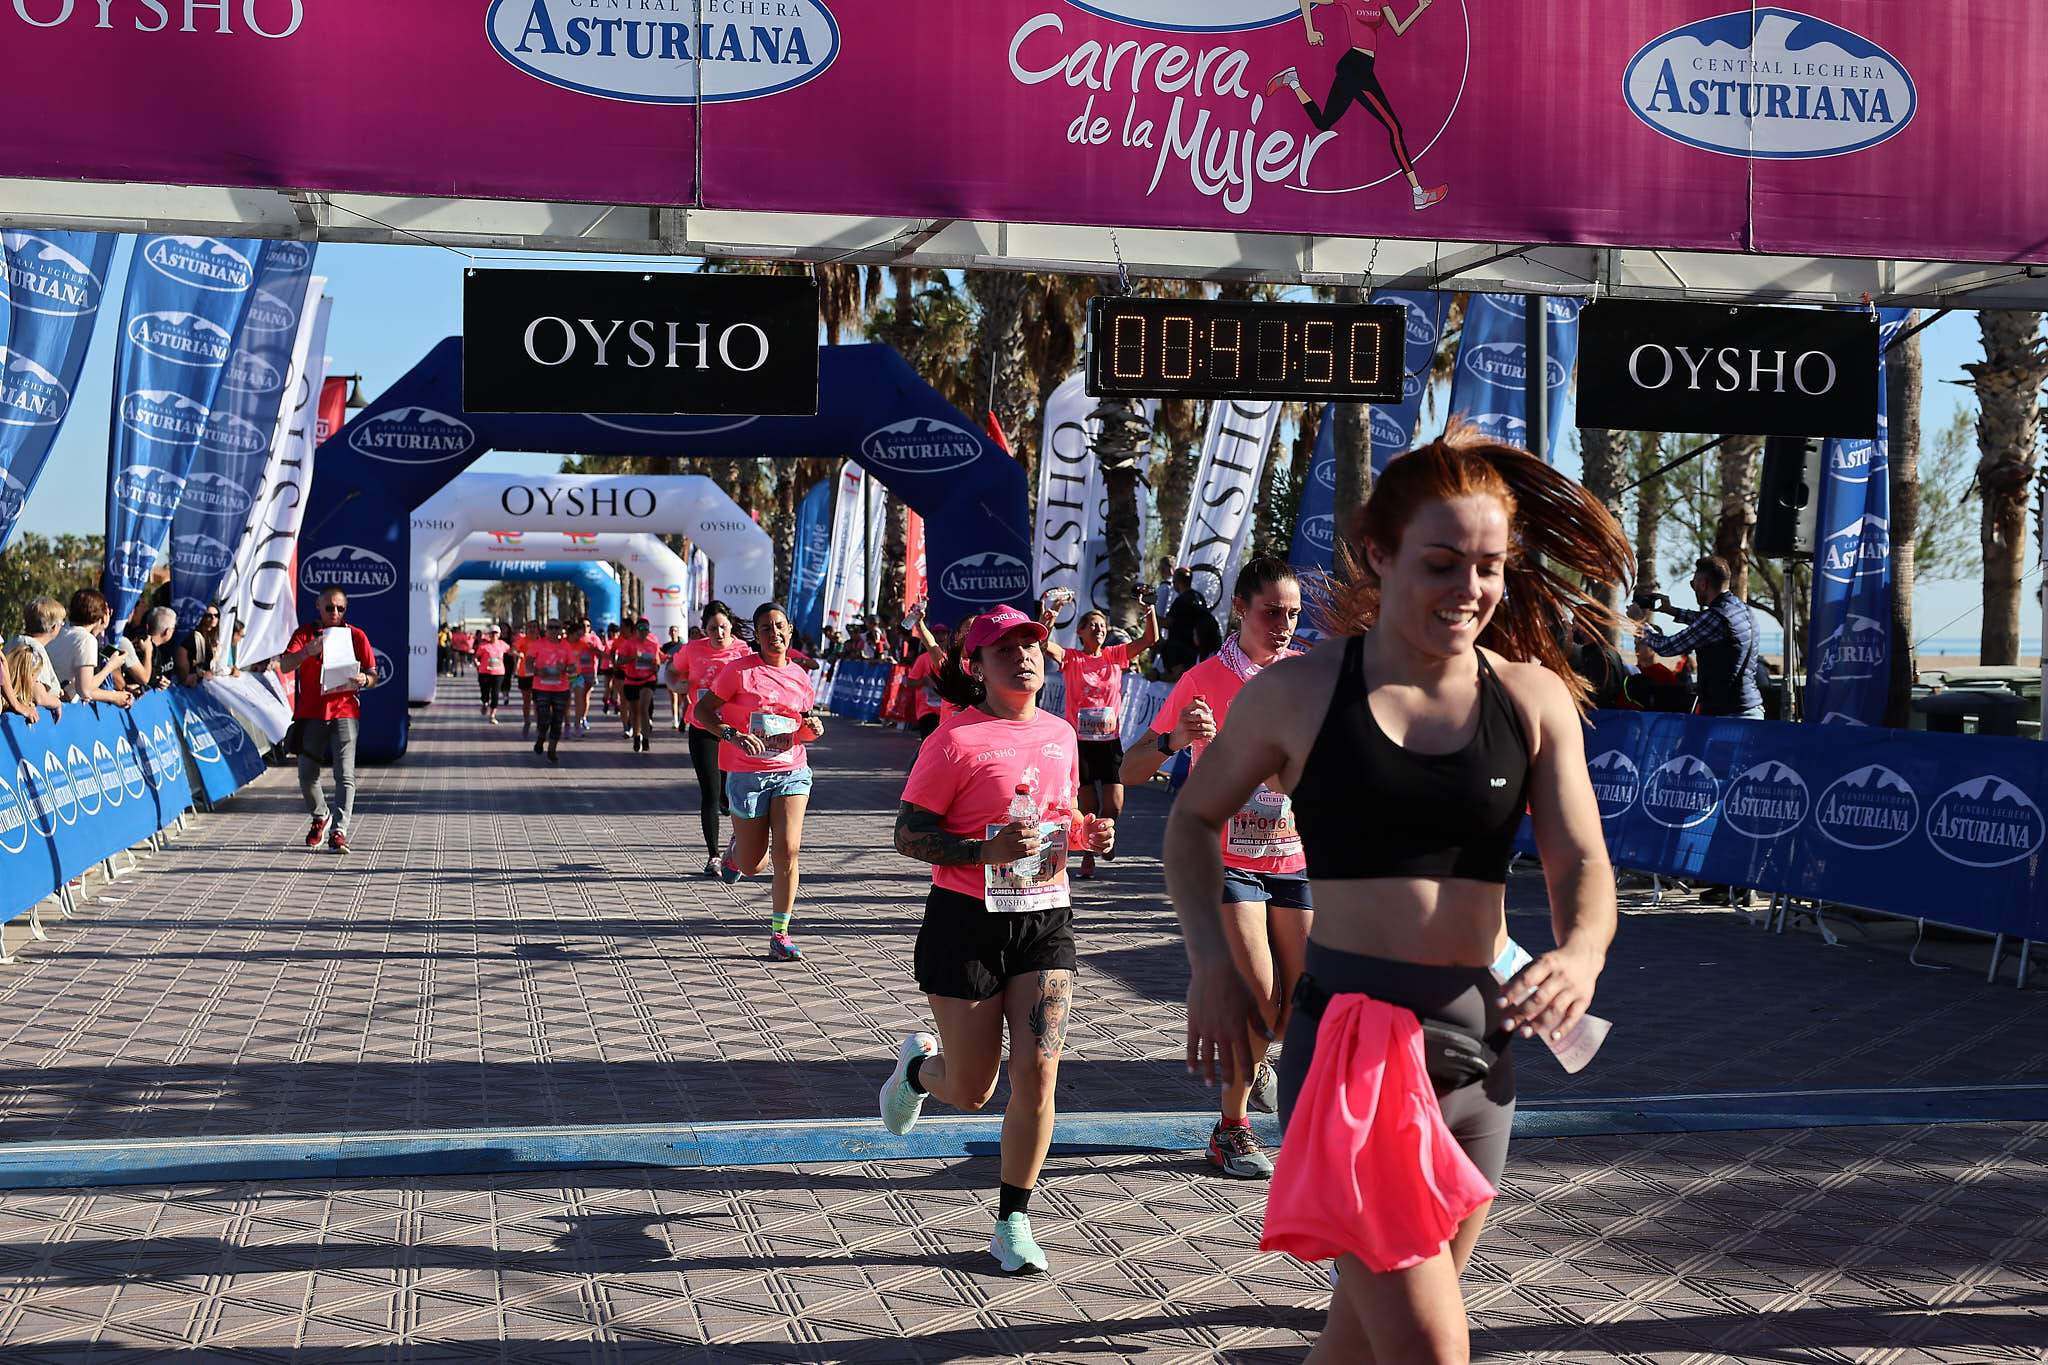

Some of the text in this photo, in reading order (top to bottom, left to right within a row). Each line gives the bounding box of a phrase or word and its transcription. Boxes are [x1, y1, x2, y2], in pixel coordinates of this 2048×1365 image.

[514, 0, 813, 65] ASTURIANA
[1008, 13, 1250, 98] Carrera
[1692, 57, 1885, 79] CENTRAL LECHERA
[1646, 58, 1894, 123] ASTURIANA
[1067, 94, 1338, 214] de la Mujer
[152, 243, 247, 287] ASTURIANA
[135, 320, 229, 361] ASTURIANA
[524, 316, 769, 372] OYSHO
[1628, 344, 1837, 395] OYSHO
[356, 428, 464, 451] ASTURIANA
[872, 439, 975, 460] ASTURIANA
[502, 485, 657, 518] OYSHO
[700, 520, 746, 532] OYSHO
[304, 564, 389, 587] ASTURIANA
[724, 584, 767, 595] OYSHO
[947, 571, 1026, 591] ASTURIANA
[1646, 772, 1711, 812] ASTURIANA
[1728, 786, 1800, 821] ASTURIANA
[1821, 793, 1909, 833] ASTURIANA
[1932, 804, 2030, 850] ASTURIANA
[996, 899, 1026, 908] OYSHO
